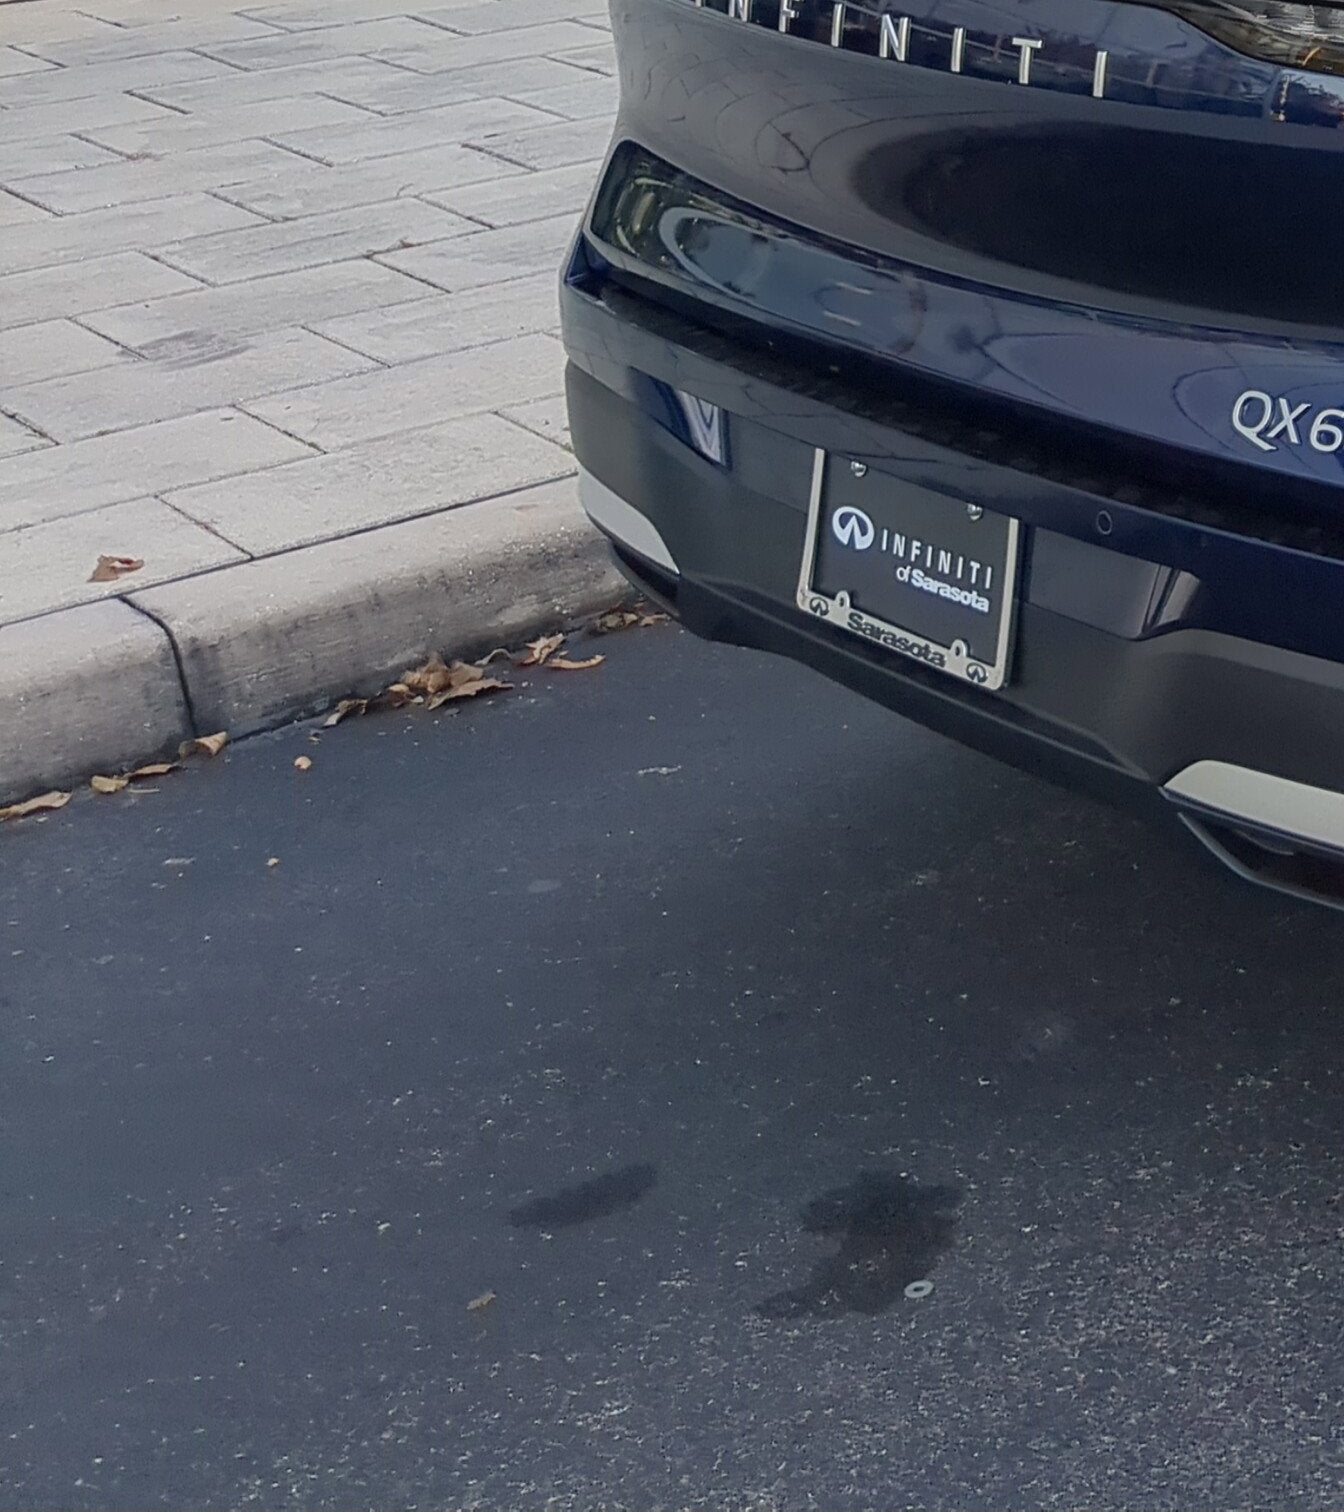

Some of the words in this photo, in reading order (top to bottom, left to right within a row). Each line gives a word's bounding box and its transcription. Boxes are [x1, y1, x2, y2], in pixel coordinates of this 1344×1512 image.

[880, 528, 993, 589] INFINITI
[896, 565, 911, 583] of
[911, 567, 990, 613] Sarasota
[847, 611, 947, 669] Sarasota
